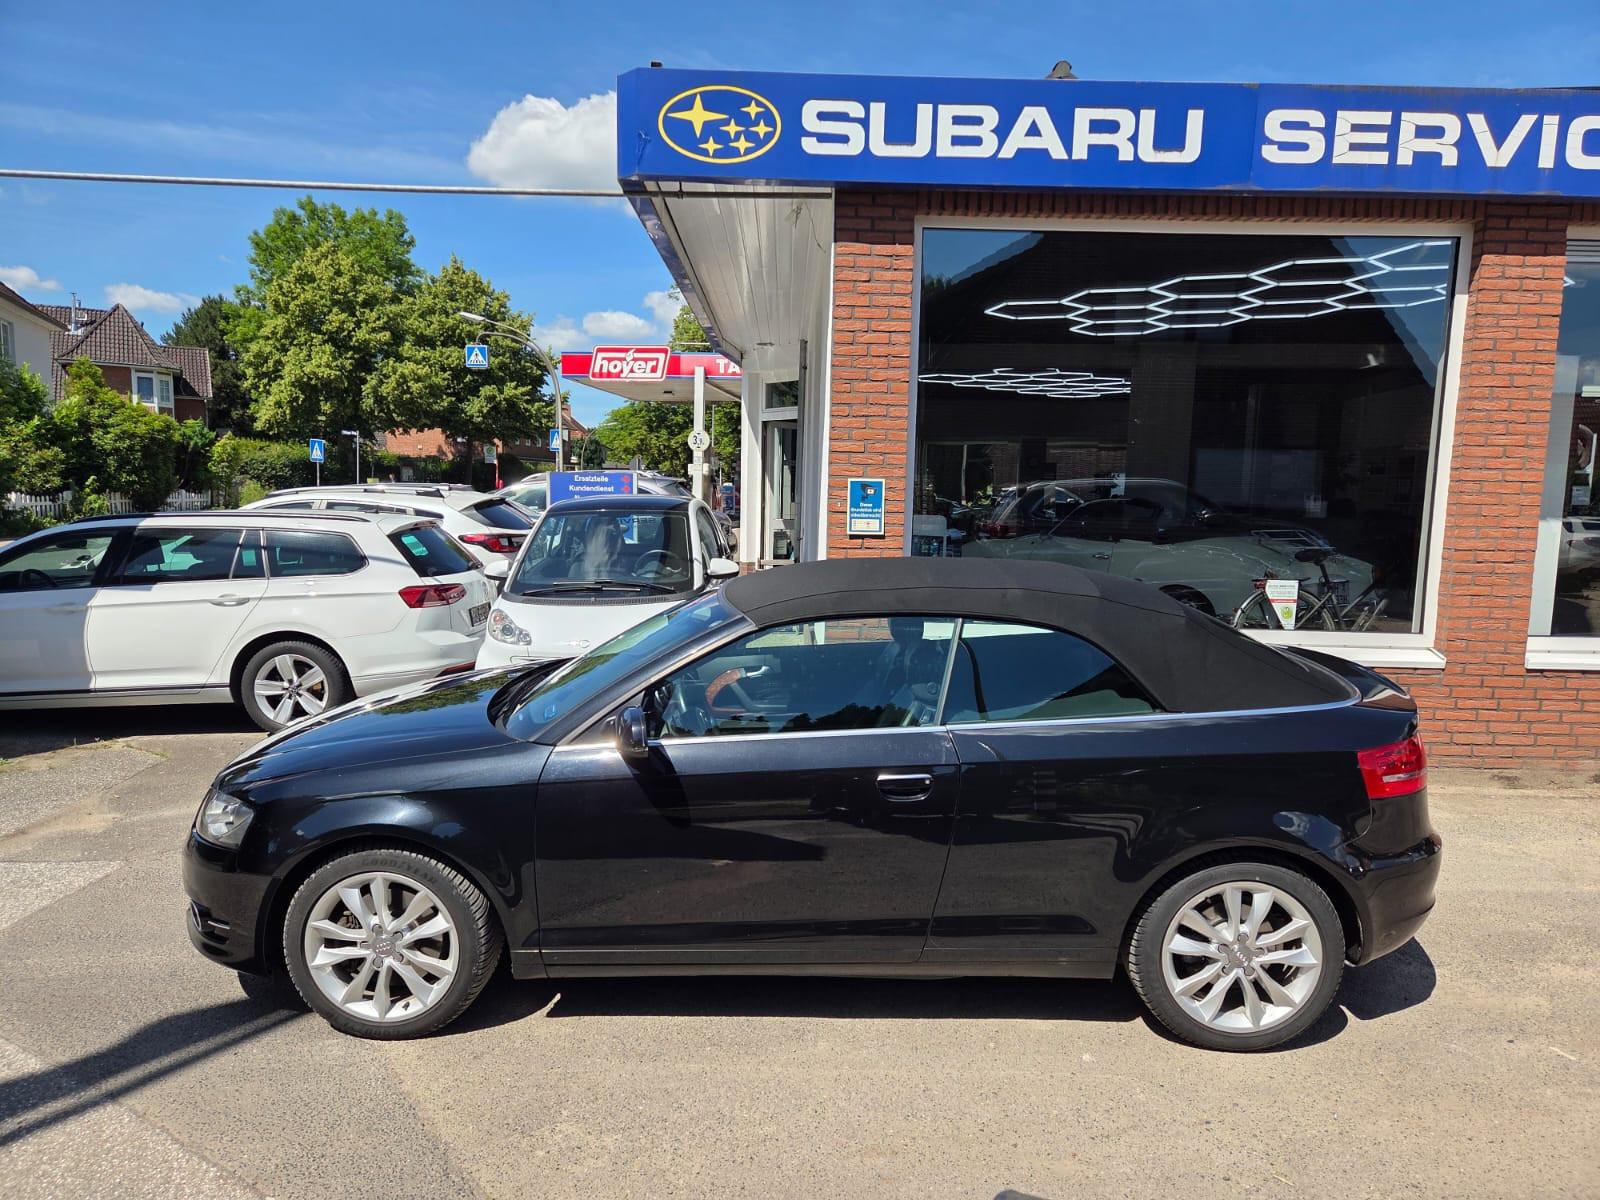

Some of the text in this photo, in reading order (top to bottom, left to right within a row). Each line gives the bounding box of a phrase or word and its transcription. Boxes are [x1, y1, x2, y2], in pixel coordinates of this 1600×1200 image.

[801, 99, 1600, 170] SUBARU SERVIC
[593, 352, 660, 378] hoyer
[574, 474, 609, 482] Ersatzteile
[569, 484, 614, 492] Kundendienst
